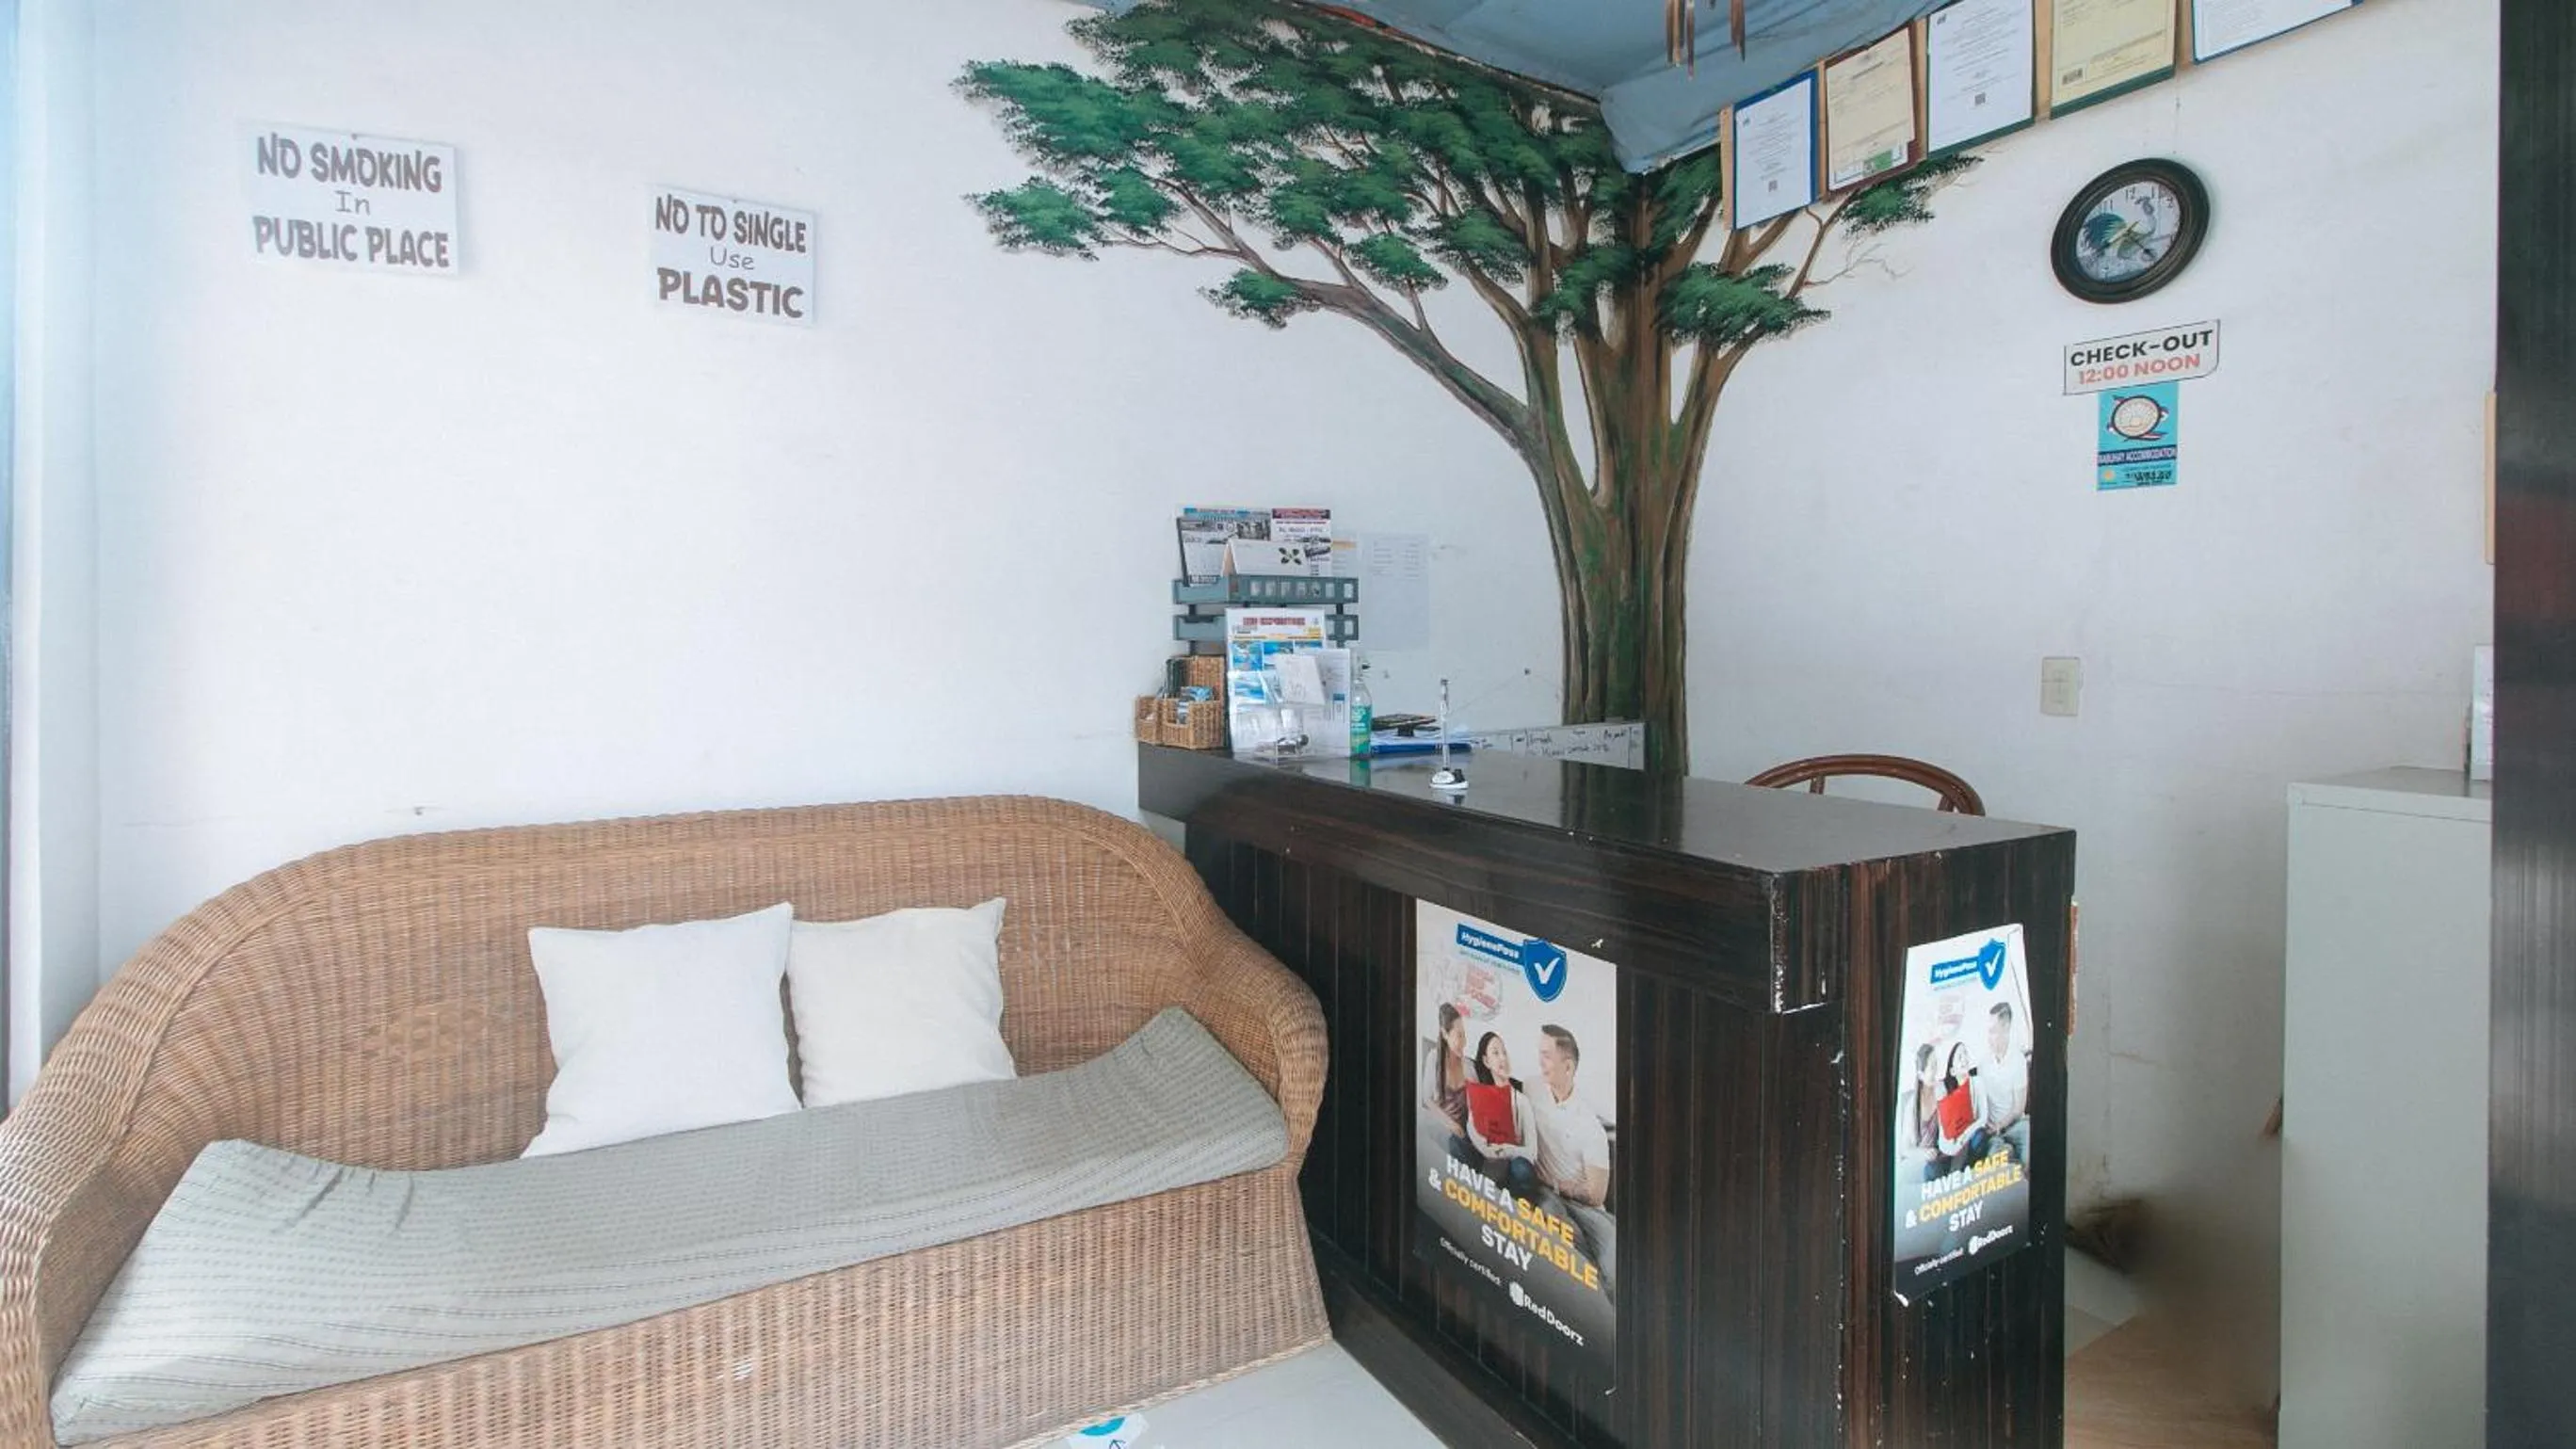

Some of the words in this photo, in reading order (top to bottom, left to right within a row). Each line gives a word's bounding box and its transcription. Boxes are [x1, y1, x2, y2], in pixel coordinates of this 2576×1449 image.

[257, 132, 301, 179] NO
[310, 141, 443, 193] SMOKING
[334, 190, 371, 216] In
[655, 193, 689, 234] NO
[696, 204, 727, 241] TO
[733, 211, 807, 253] SINGLE
[252, 216, 358, 262] PUBLIC
[365, 226, 450, 267] PLACE
[710, 246, 755, 270] Use
[657, 267, 804, 318] PLASTIC
[2071, 330, 2213, 366] CHECK-OUT
[2079, 364, 2129, 385] 12:00
[2134, 354, 2200, 377] NOON
[1919, 1164, 2023, 1222] COMFORTABLE
[1921, 1169, 1962, 1201] HAVE
[1962, 1165, 1973, 1185] A
[1973, 1149, 2009, 1176] SAFE
[1446, 1153, 1497, 1201] HAVE
[1500, 1188, 1514, 1213] A
[1517, 1197, 1575, 1249] SAFE
[1949, 1199, 1984, 1232] STAY
[1428, 1167, 1441, 1192] &
[1444, 1178, 1599, 1291] COMFORTABLE
[1481, 1224, 1534, 1271] STAY
[1524, 1294, 1585, 1346] RedDoorz
